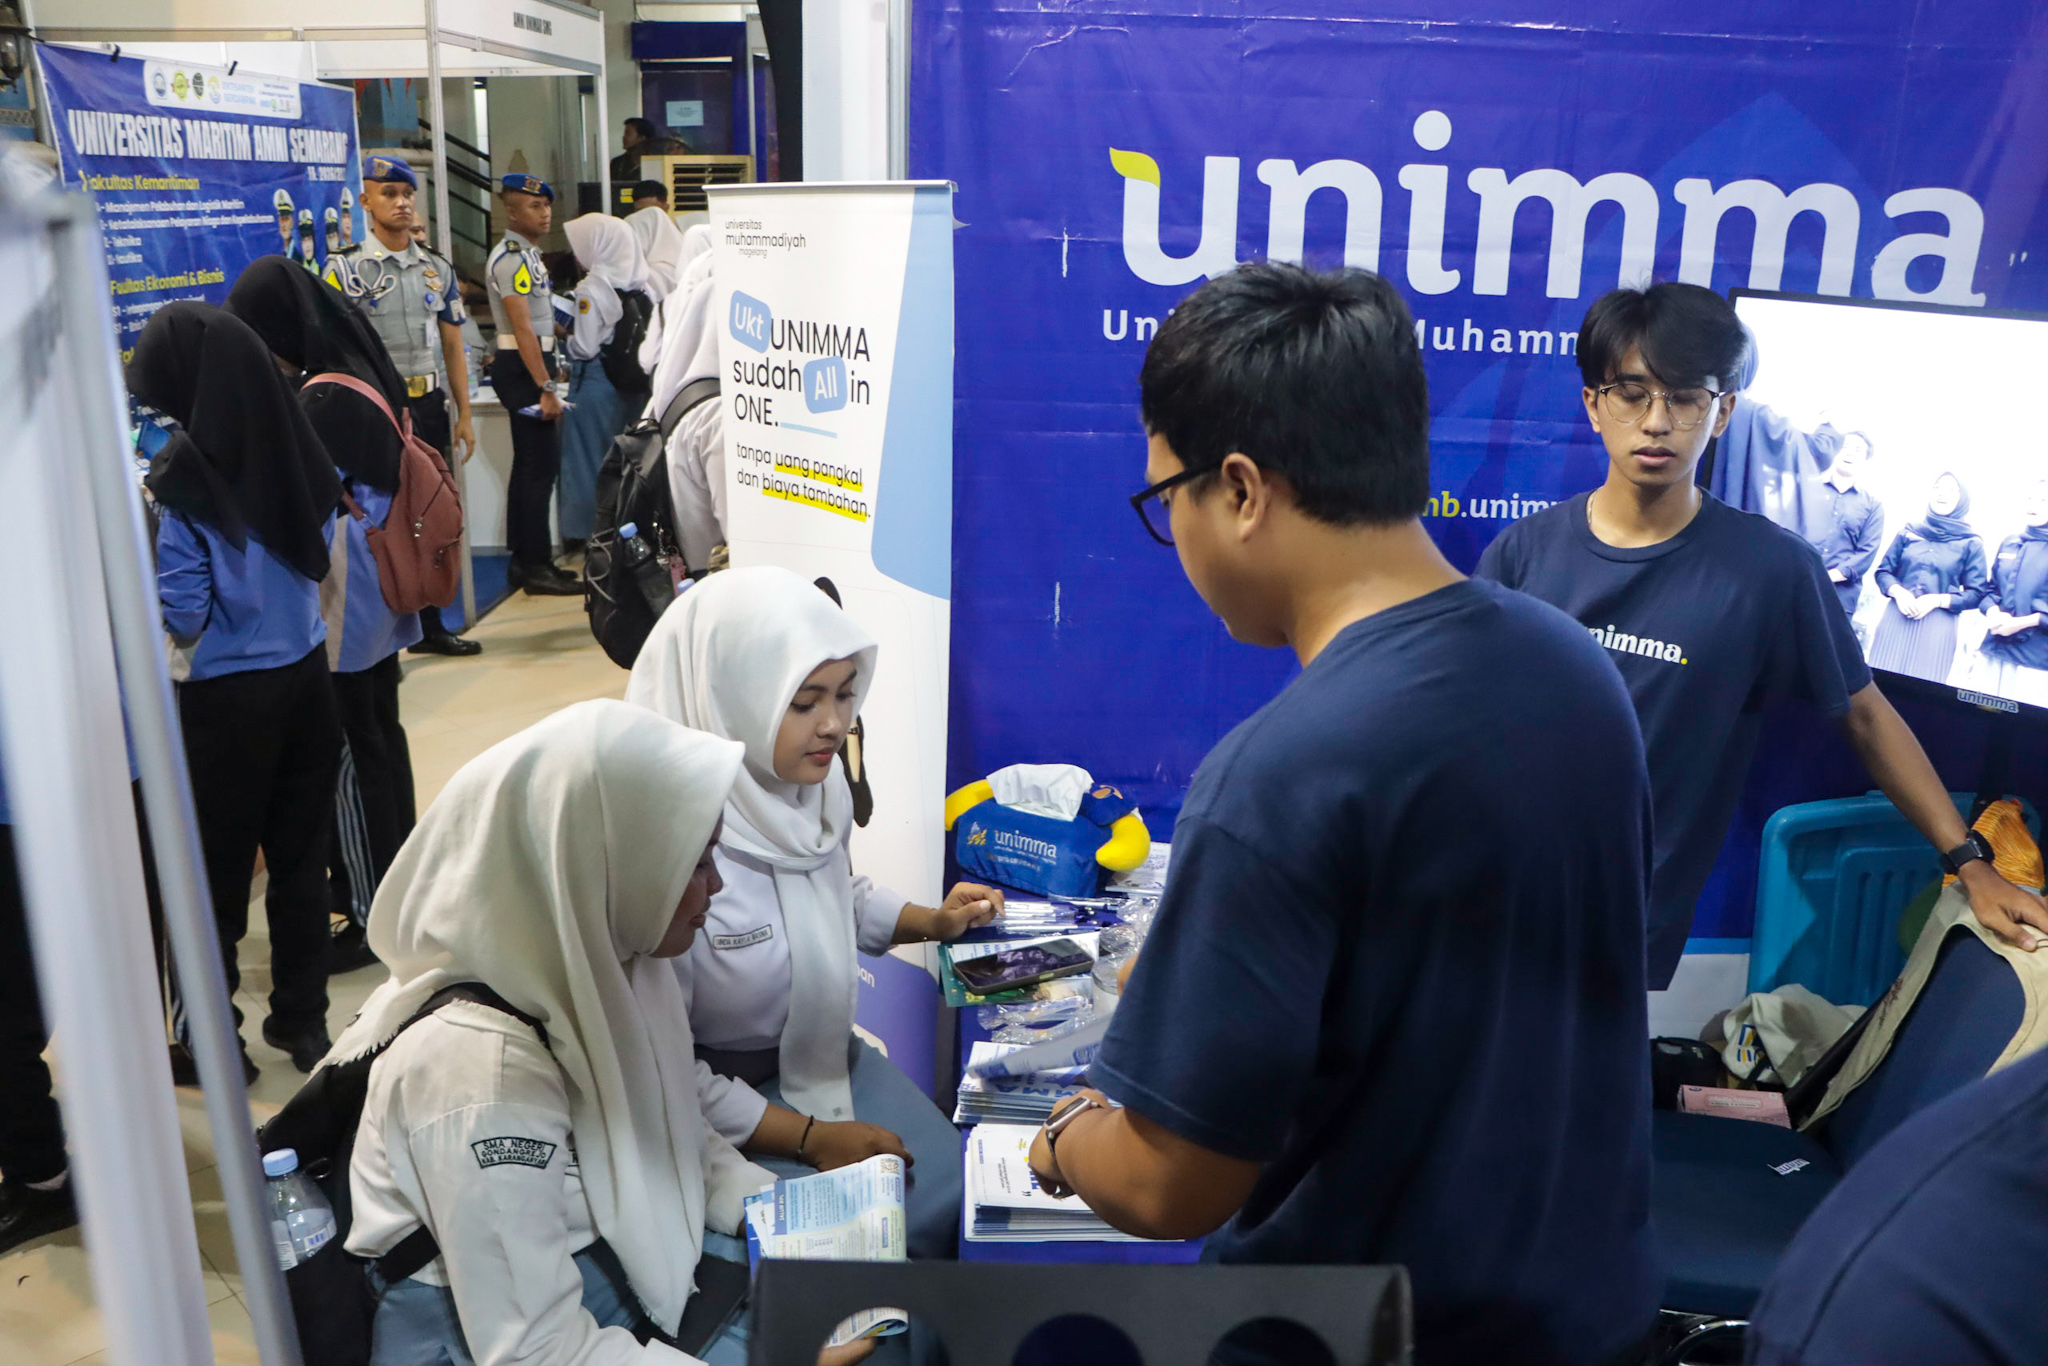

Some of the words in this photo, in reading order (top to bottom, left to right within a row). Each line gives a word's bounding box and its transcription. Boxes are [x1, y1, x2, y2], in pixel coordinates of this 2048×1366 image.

[67, 109, 184, 159] UNIVERSITAS
[184, 119, 252, 161] MARITIM
[253, 124, 289, 163] AMNI
[89, 174, 134, 190] akultas
[134, 174, 199, 190] Kemaritiman
[186, 200, 198, 211] dan
[1109, 109, 1986, 308] unimma
[725, 219, 762, 231] universitas
[725, 232, 806, 251] muhammadiyah
[738, 247, 768, 259] magelang
[145, 270, 189, 291] Ekonomi
[189, 271, 197, 286] &
[196, 267, 225, 285] Bisnis
[734, 302, 764, 340] Ukt
[770, 318, 870, 362] UNIMMA
[1103, 308, 1176, 341] Un
[733, 357, 802, 393] sudah
[814, 365, 839, 401] All
[851, 370, 870, 405] in
[734, 393, 779, 427] ONE.
[736, 441, 772, 467] tanpa
[775, 452, 810, 478] uang
[813, 464, 863, 488] pangkal
[737, 468, 759, 488] dan
[762, 473, 800, 500] biaya
[803, 483, 871, 518] tambahan.
[1584, 624, 1688, 665] nimma.
[1958, 688, 2019, 713] unimma
[994, 829, 1057, 858] unimma
[481, 1148, 547, 1159] GONDANGREJO
[483, 1139, 506, 1151] SMA
[511, 1139, 545, 1152] NEGERI
[498, 1154, 547, 1165] KARANGANYAR
